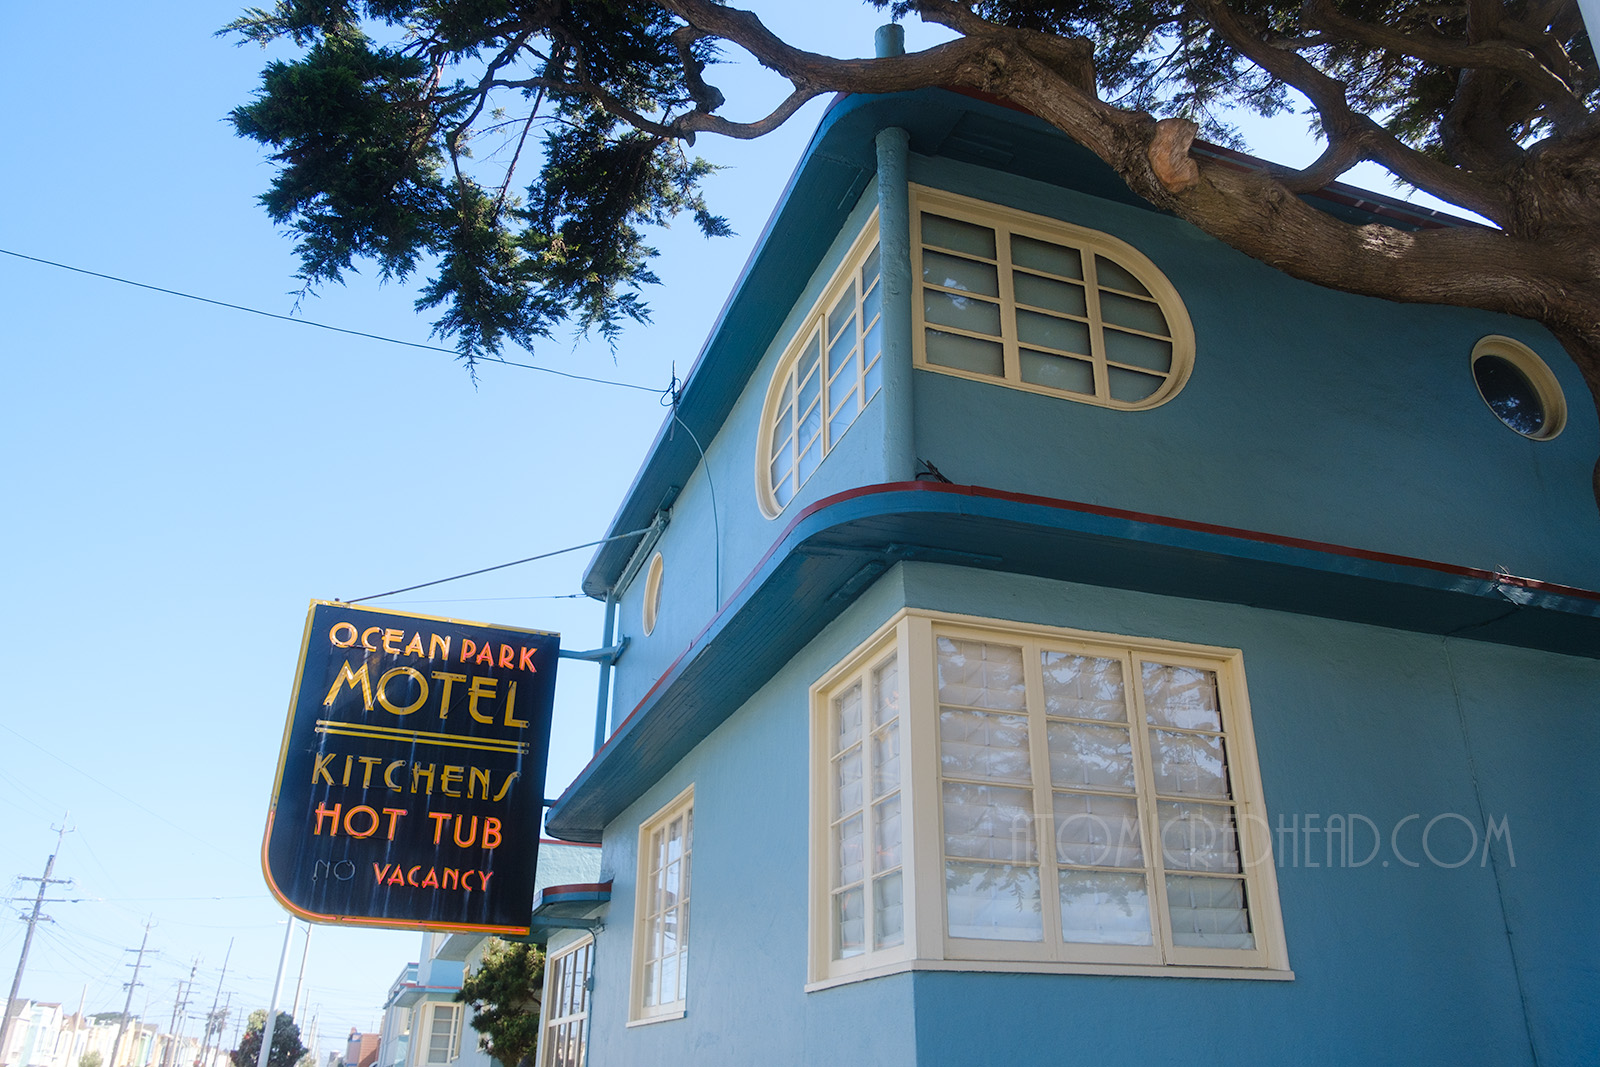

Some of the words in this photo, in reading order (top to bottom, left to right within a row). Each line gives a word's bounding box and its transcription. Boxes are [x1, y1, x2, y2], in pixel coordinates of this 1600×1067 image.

[329, 621, 451, 661] OCEAN
[460, 638, 538, 673] PARK
[322, 659, 530, 728] MOTEL
[311, 752, 521, 802] KITCHENS
[314, 801, 407, 841] HOT
[428, 811, 502, 849] TUB
[312, 859, 356, 882] NO
[373, 862, 493, 892] VACANCY
